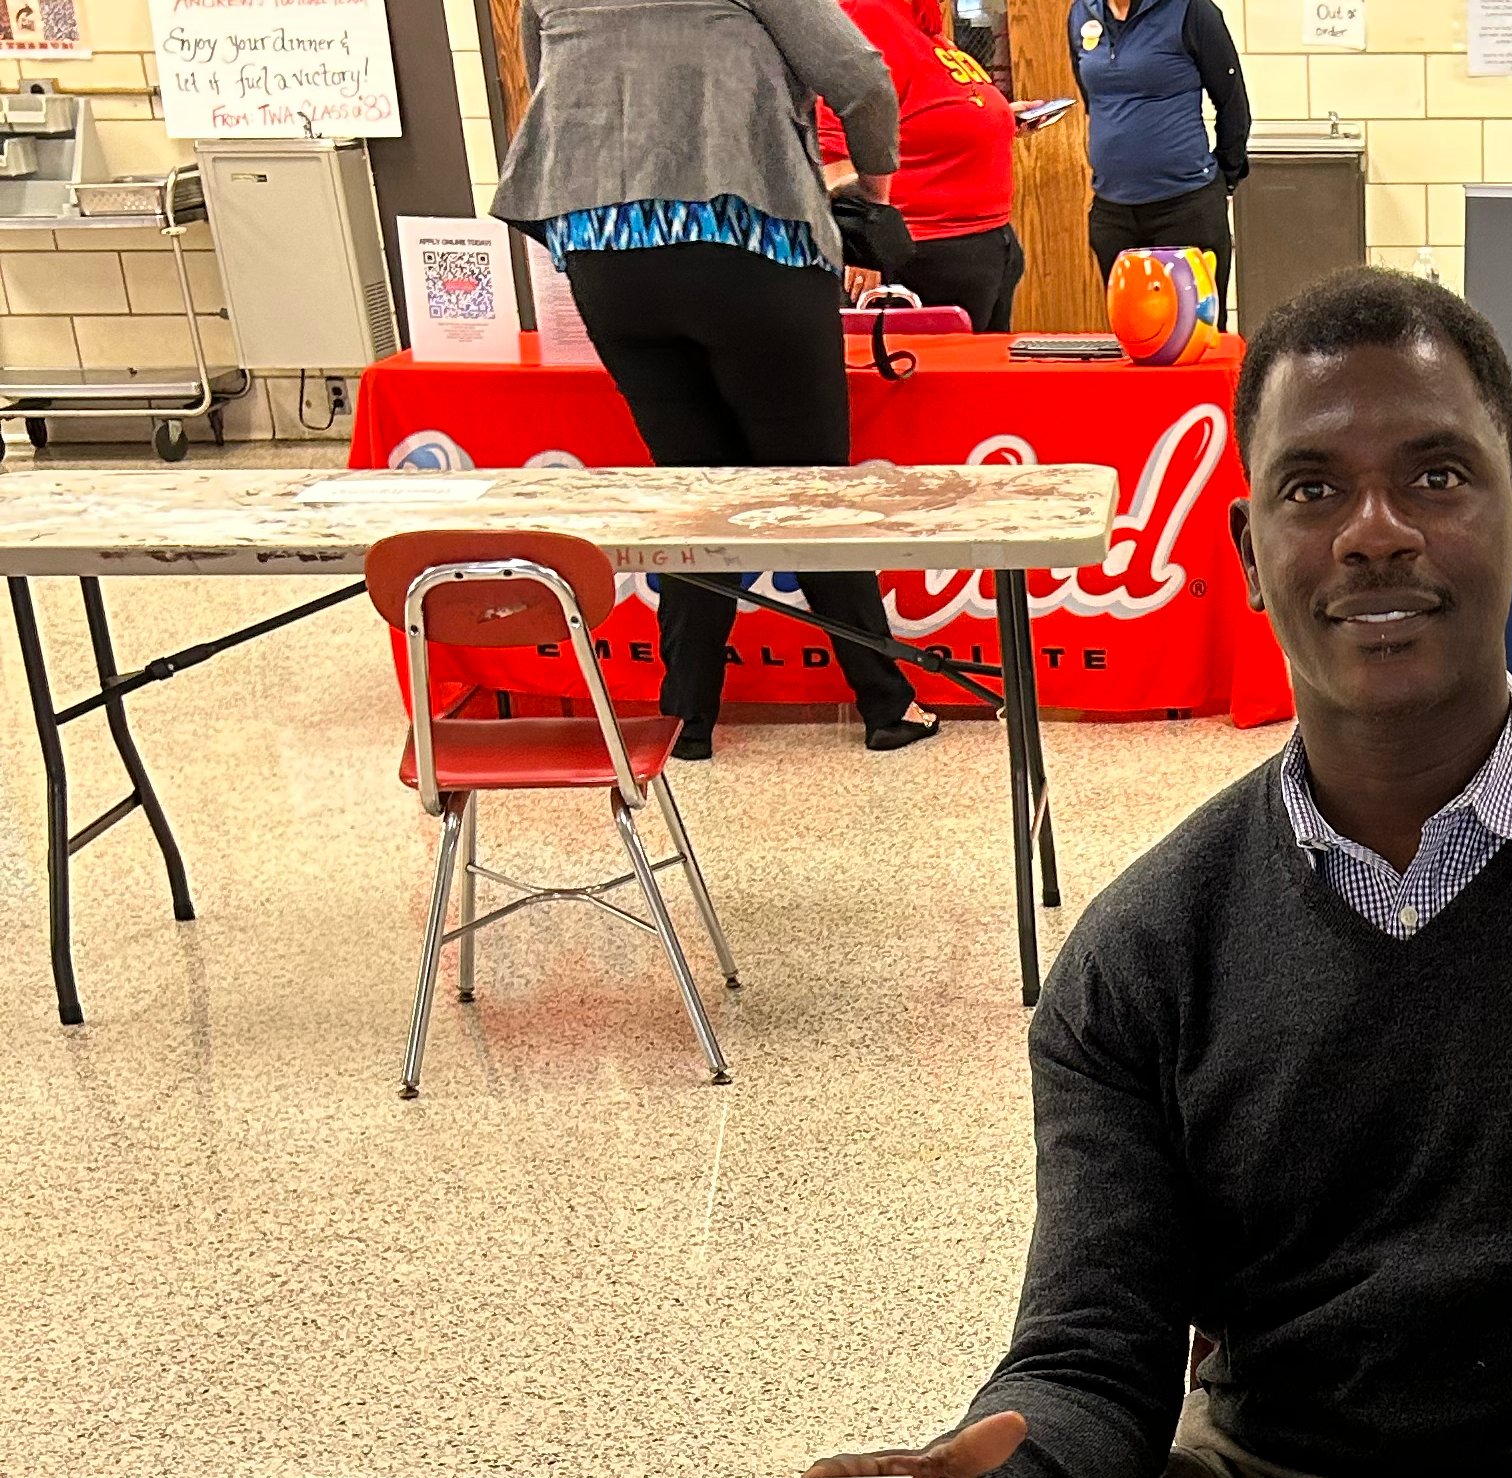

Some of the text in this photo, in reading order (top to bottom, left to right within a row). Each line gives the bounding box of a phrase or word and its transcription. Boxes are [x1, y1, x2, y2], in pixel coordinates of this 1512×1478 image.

[1316, 4, 1343, 20] Out
[1316, 25, 1348, 37] order
[163, 27, 217, 63] Enjoy
[223, 34, 270, 63] your
[272, 28, 335, 52] dinner
[175, 57, 369, 98] let it fuel a victory!
[257, 104, 296, 126] TWA
[419, 238, 440, 246] APPLY
[616, 547, 696, 567] HIGH
[536, 638, 830, 668] EMEALD
